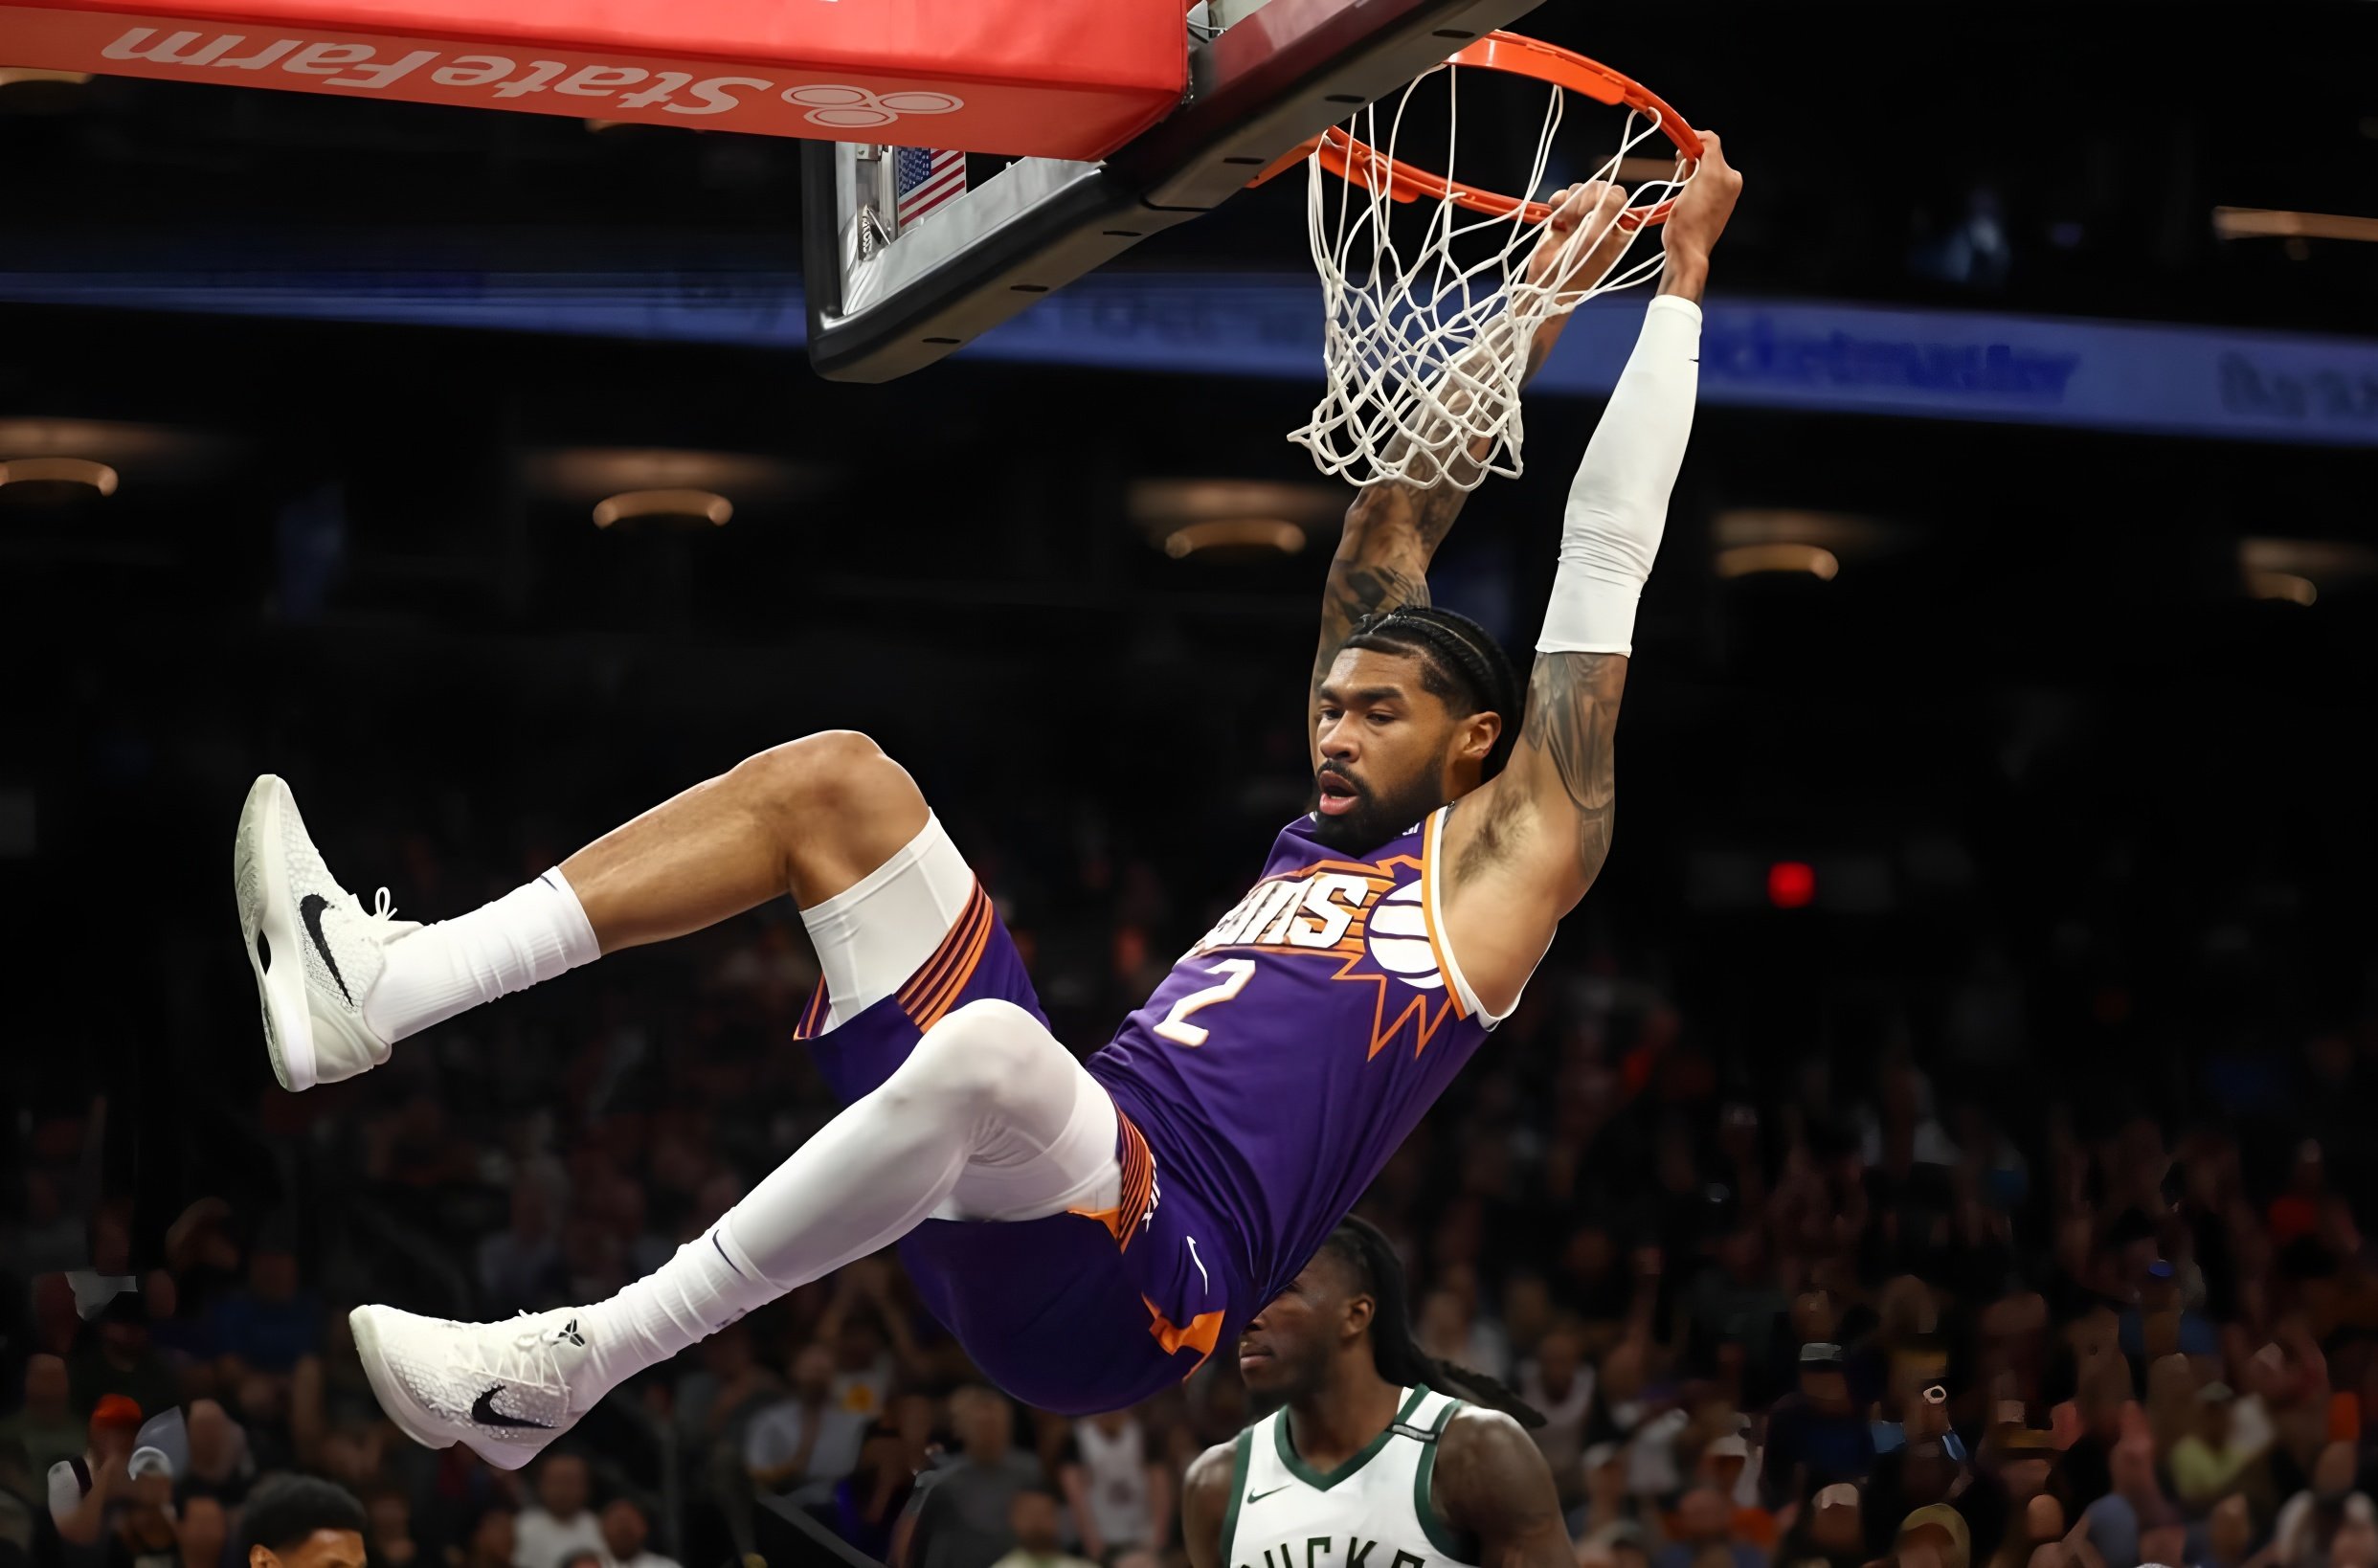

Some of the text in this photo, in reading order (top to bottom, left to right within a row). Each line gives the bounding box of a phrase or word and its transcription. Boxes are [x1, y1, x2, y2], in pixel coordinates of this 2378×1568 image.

[1173, 872, 1369, 967] UNS
[1153, 958, 1256, 1048] 2
[1240, 1535, 1426, 1568] UCK
